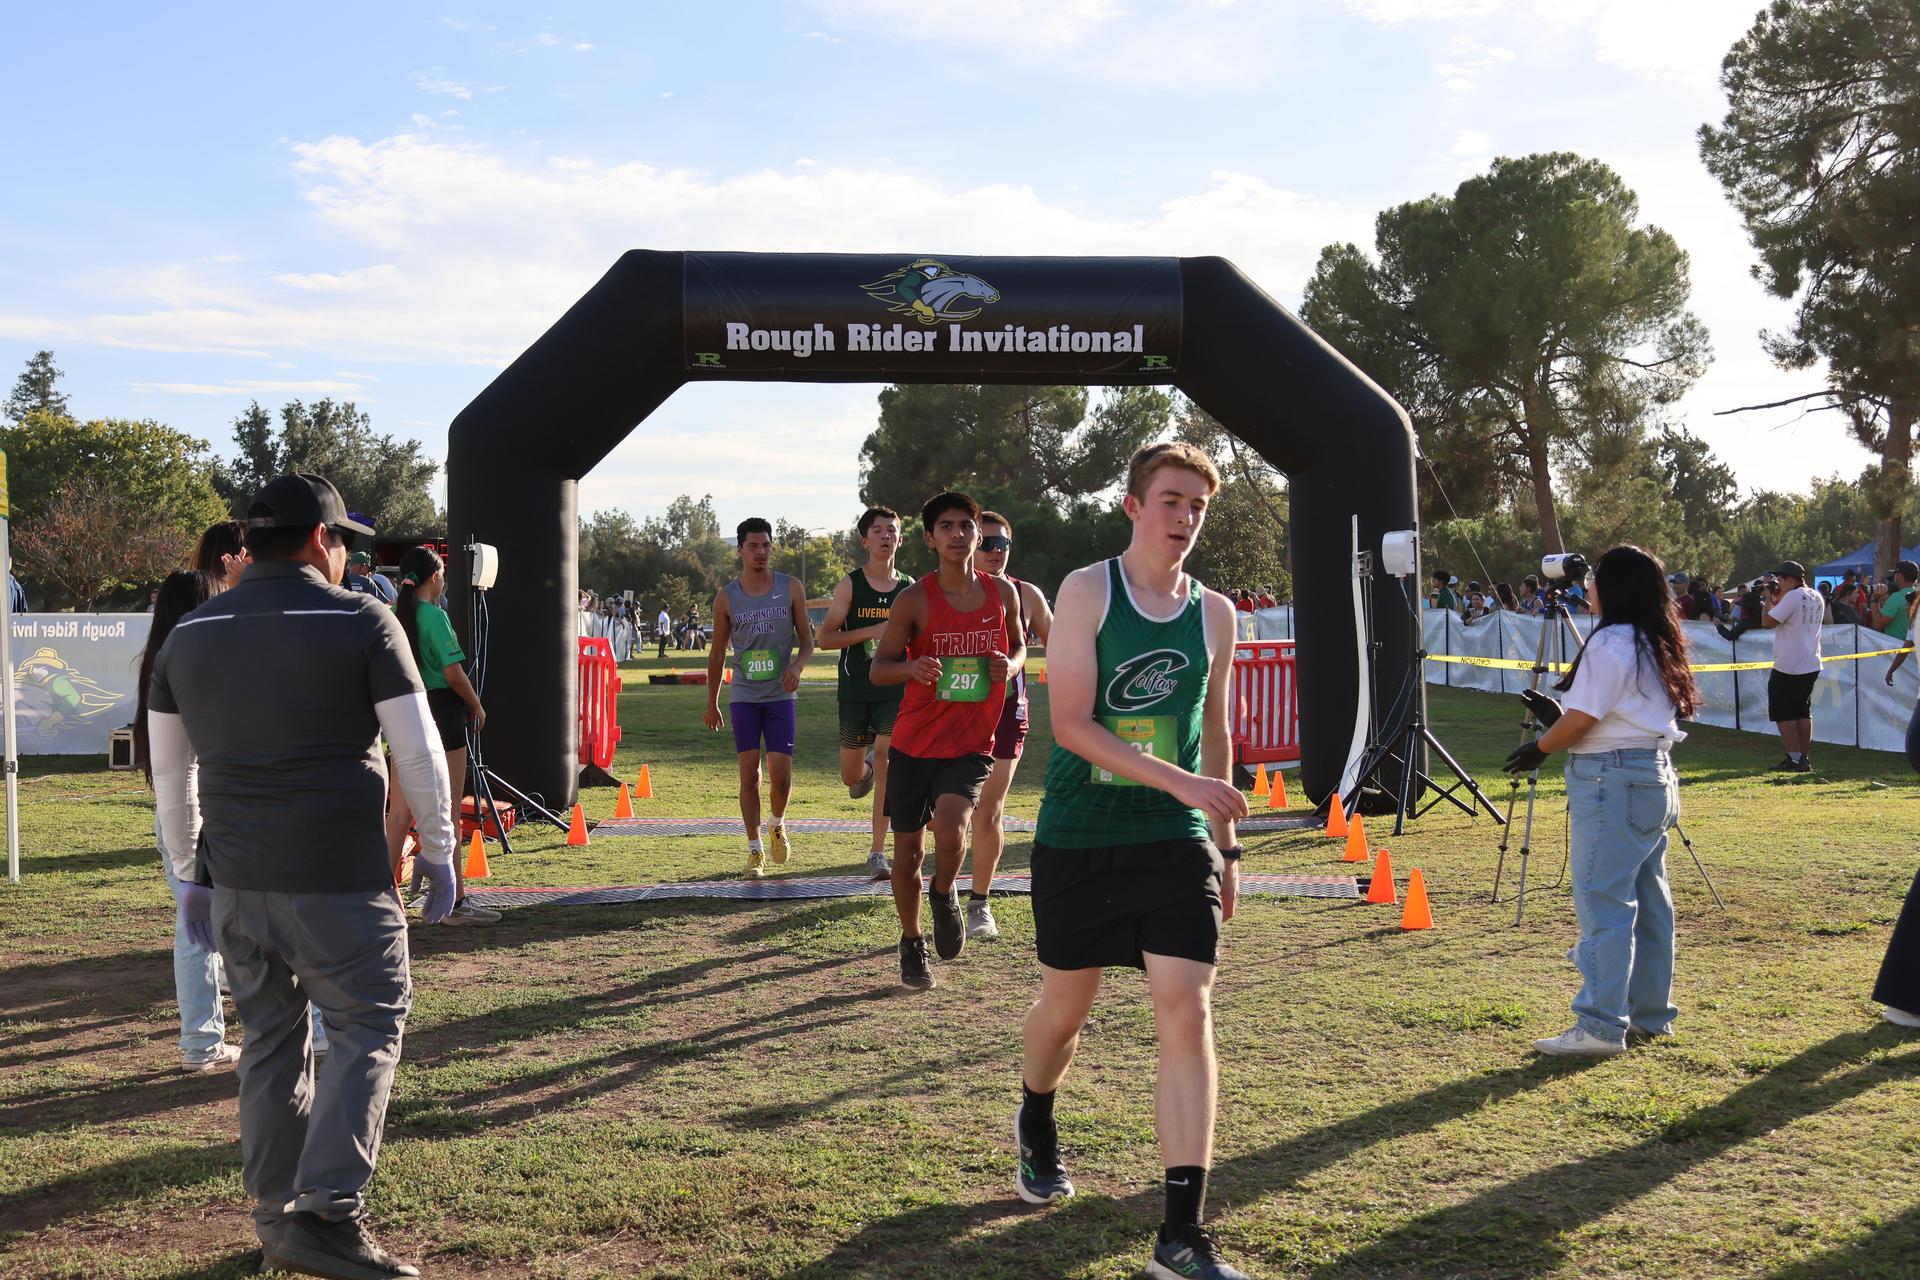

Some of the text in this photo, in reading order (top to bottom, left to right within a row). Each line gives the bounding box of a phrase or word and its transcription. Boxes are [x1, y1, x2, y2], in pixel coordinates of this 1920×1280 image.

[726, 322, 1143, 358] Rough Rider Invitational
[735, 607, 788, 624] WASHINGTON
[857, 607, 890, 618] LIVERM
[751, 622, 775, 635] UNION
[932, 628, 1001, 656] TRIBE
[748, 660, 774, 673] 2019
[1460, 657, 1491, 666] CAUTION
[1516, 662, 1534, 670] TION
[950, 673, 980, 690] 297
[1106, 648, 1190, 712] Colfax
